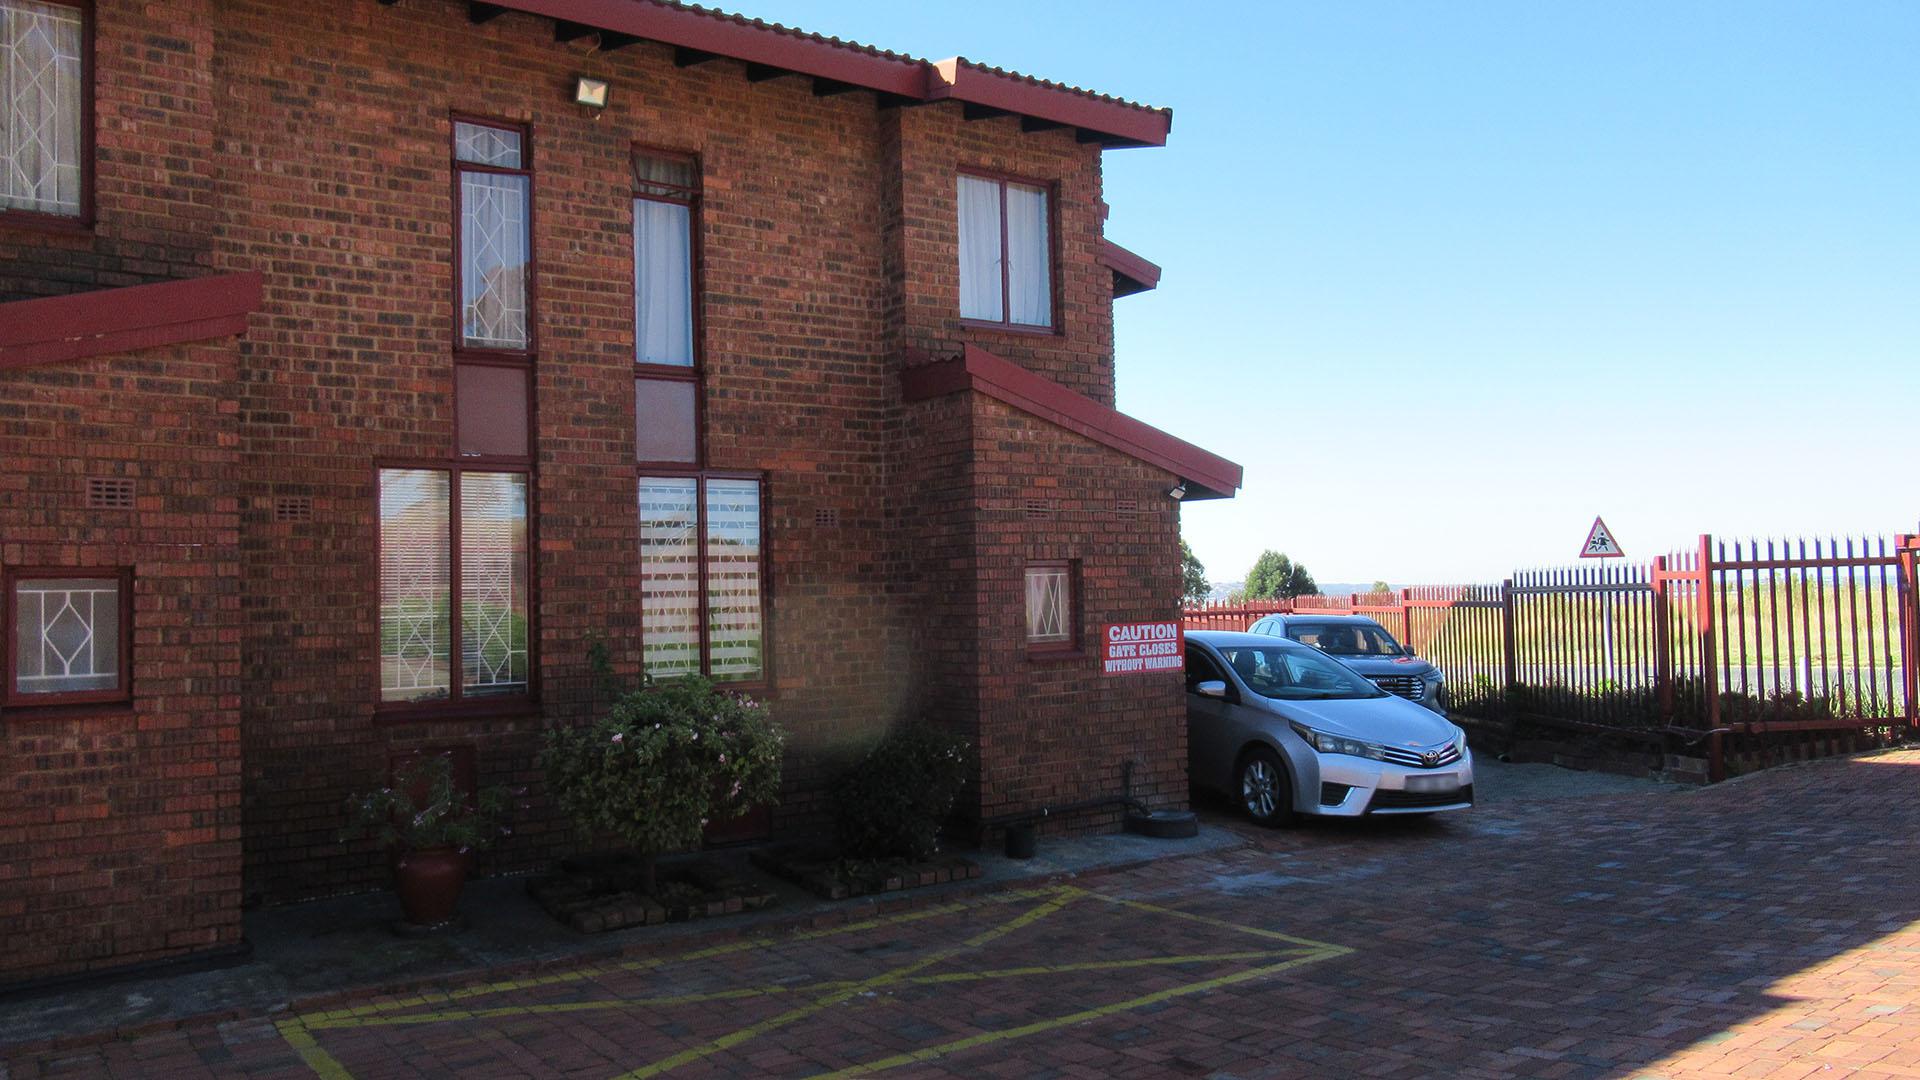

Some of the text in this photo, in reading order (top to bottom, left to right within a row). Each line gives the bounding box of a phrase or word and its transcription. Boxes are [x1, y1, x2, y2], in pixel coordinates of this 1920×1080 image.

[1109, 624, 1177, 641] CAUTION
[1109, 642, 1177, 658] GATE CLOSES
[1105, 656, 1182, 672] WITHOUT WARNING
